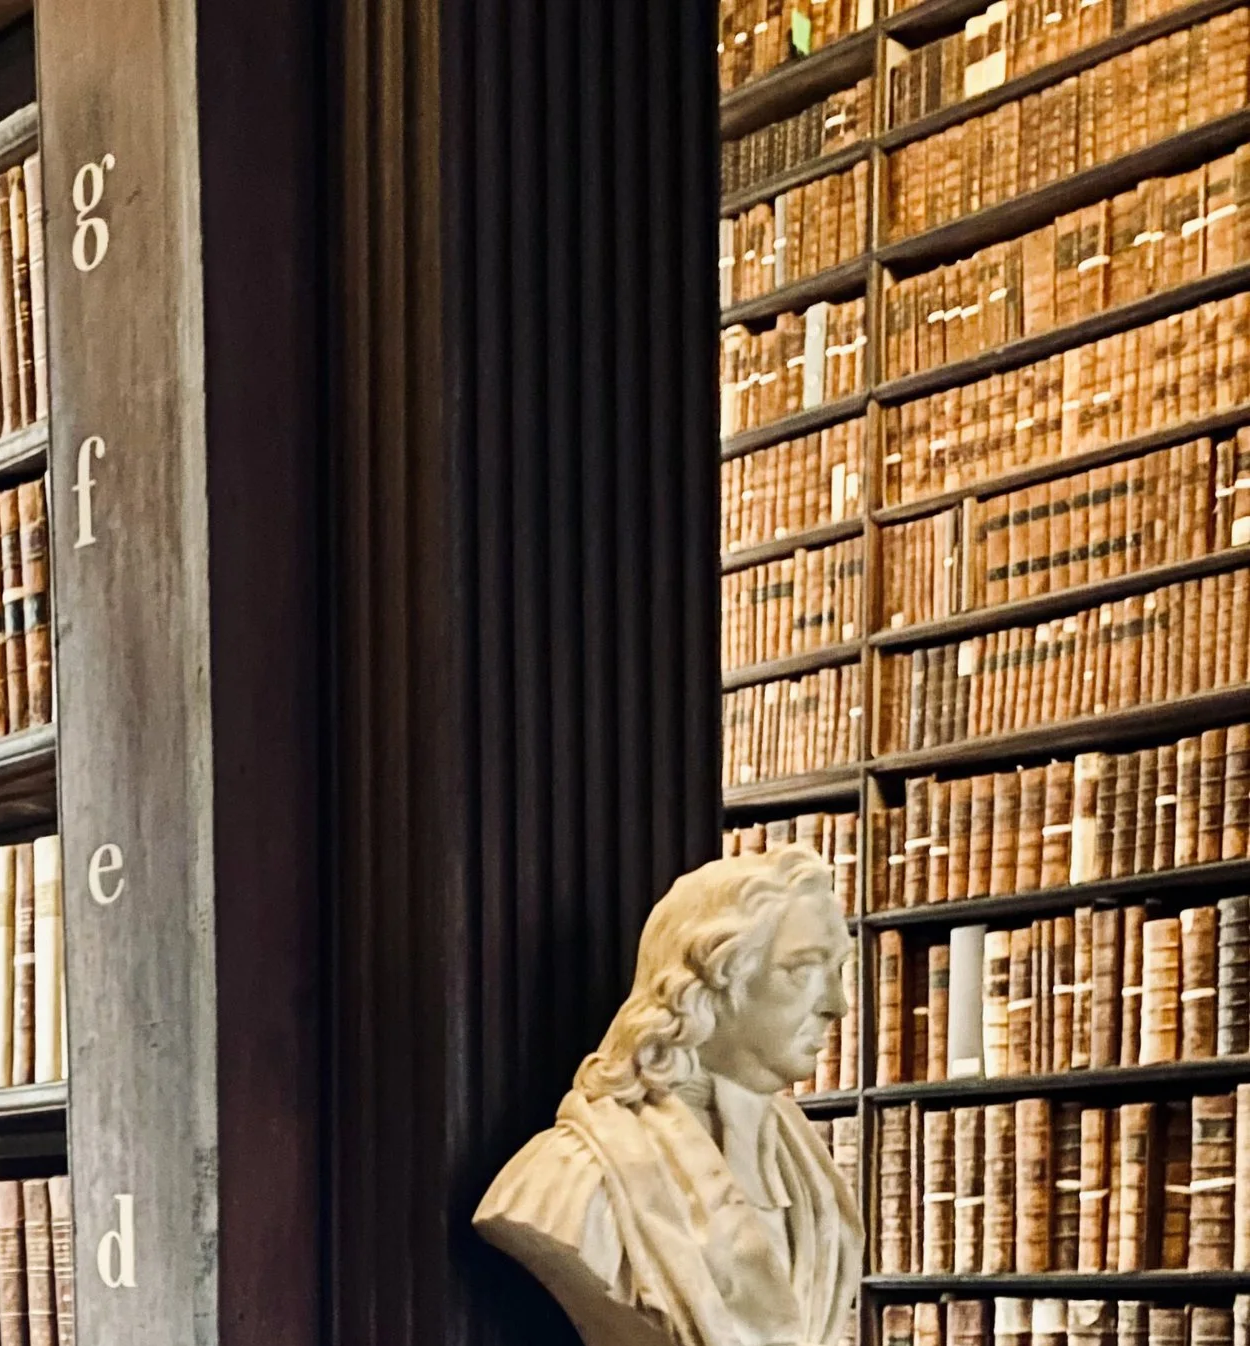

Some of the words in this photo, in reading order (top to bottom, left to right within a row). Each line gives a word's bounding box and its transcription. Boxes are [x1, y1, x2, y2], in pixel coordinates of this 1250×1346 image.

[72, 154, 116, 272] g
[71, 435, 106, 550] f
[87, 843, 125, 905] e
[96, 1193, 137, 1289] d
